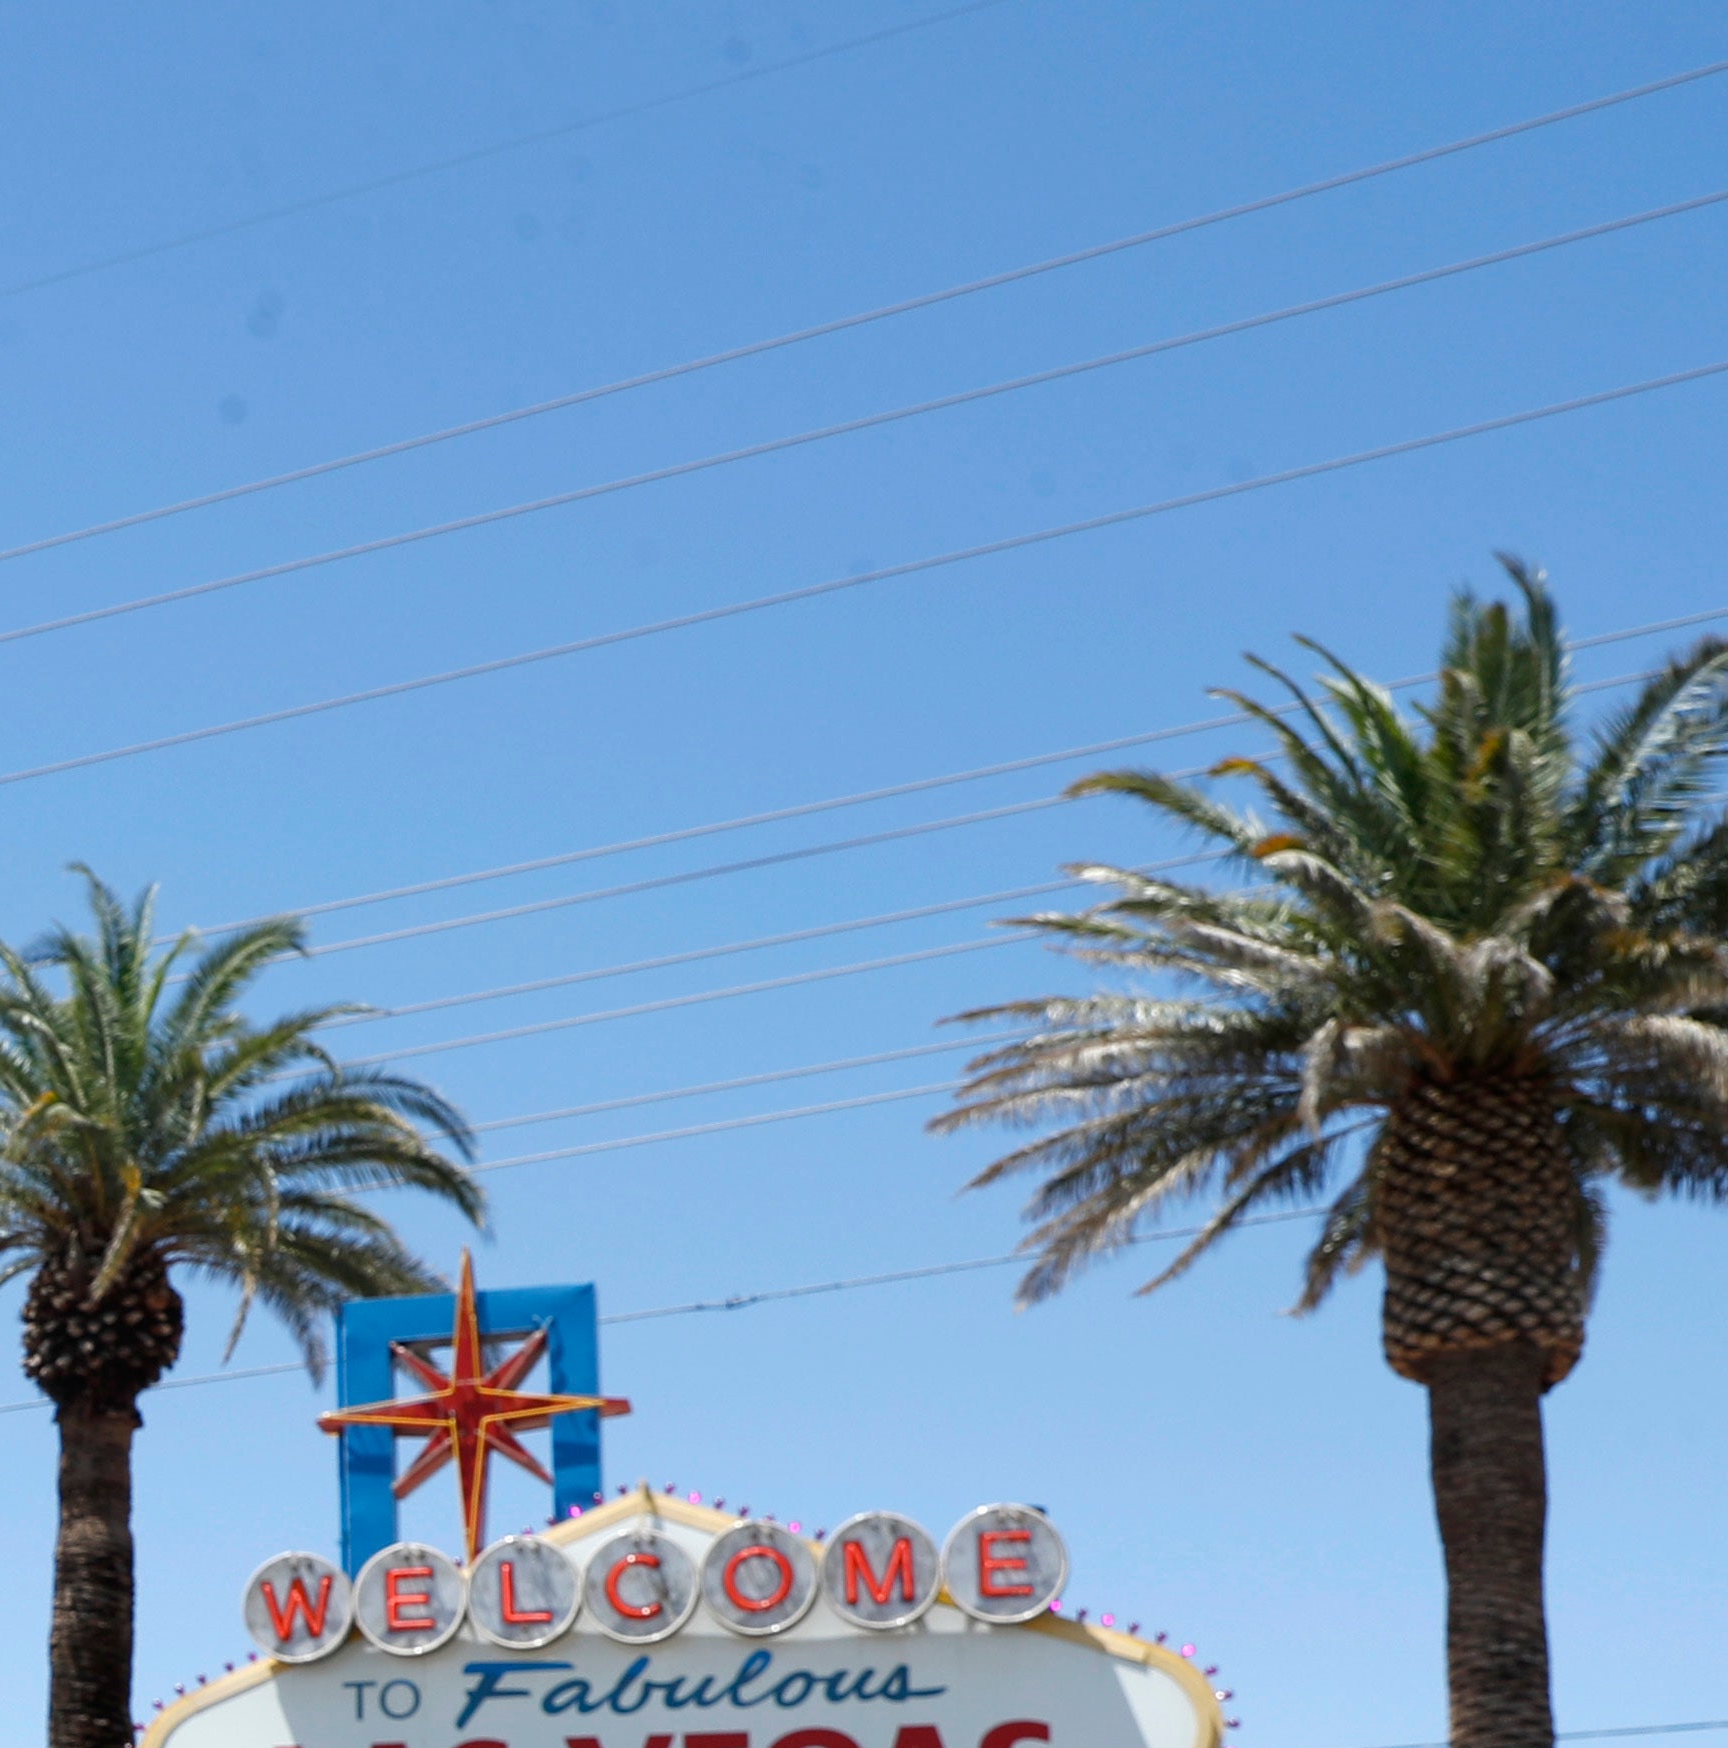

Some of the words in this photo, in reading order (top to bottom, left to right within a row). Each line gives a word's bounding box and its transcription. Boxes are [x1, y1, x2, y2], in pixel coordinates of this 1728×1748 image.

[260, 1529, 1035, 1643] WELCOME
[343, 1678, 422, 1721] TO
[455, 1648, 948, 1730] Fabulous
